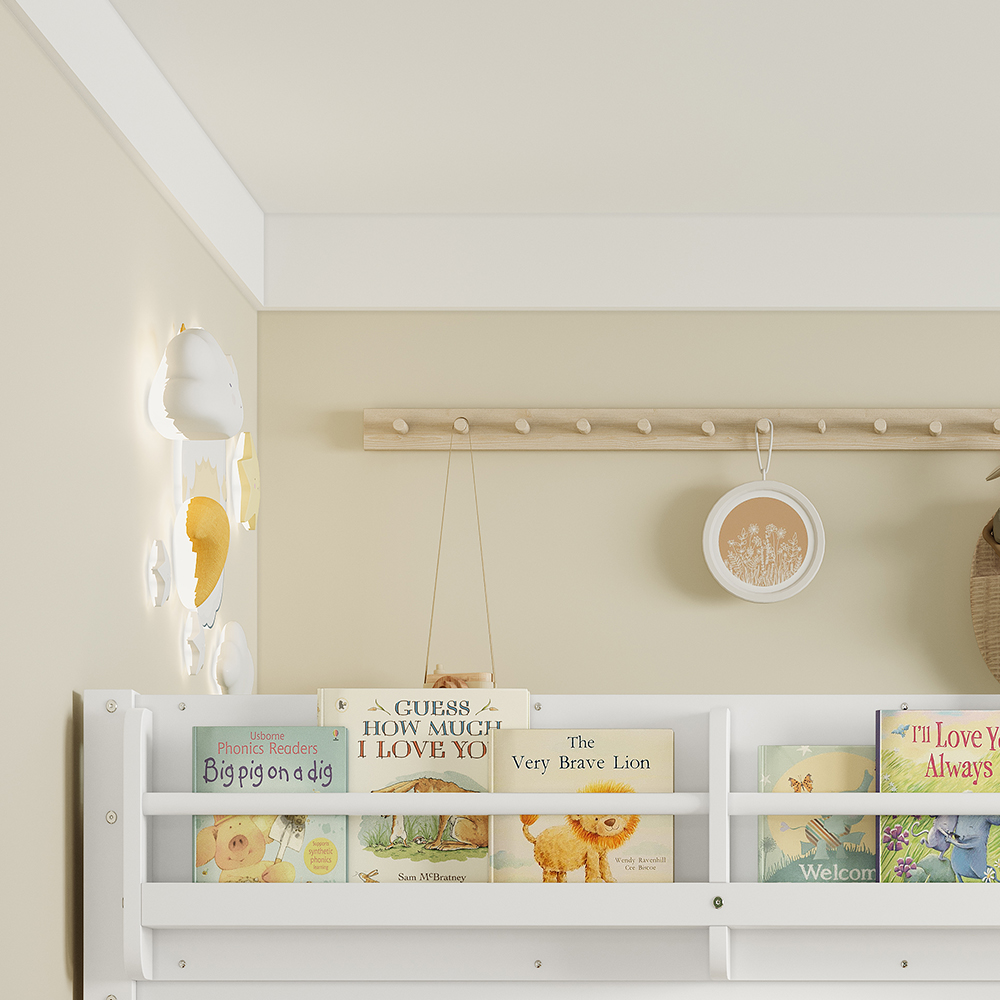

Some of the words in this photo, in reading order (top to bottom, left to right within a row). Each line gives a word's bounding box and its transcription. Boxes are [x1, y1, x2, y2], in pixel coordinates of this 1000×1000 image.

[394, 699, 471, 717] GUESS
[250, 731, 285, 741] Usborne
[362, 720, 422, 737] HOW
[428, 720, 503, 737] MUCH
[935, 721, 983, 748] Love
[217, 741, 265, 755] Phonics
[269, 741, 318, 755] Readers
[357, 740, 367, 759] I
[375, 740, 446, 760] LOVE
[450, 740, 489, 760] YO
[566, 734, 595, 749] The
[203, 756, 235, 788] Big
[238, 759, 264, 789] pig
[267, 765, 289, 783] on
[293, 765, 303, 782] a
[307, 759, 334, 788] dig
[511, 755, 551, 776] Very
[559, 755, 605, 771] Brave
[613, 755, 651, 771] Lion
[924, 752, 994, 786] Always
[310, 856, 332, 865] phonics
[614, 856, 636, 865] Wendy
[397, 872, 417, 882] Sam
